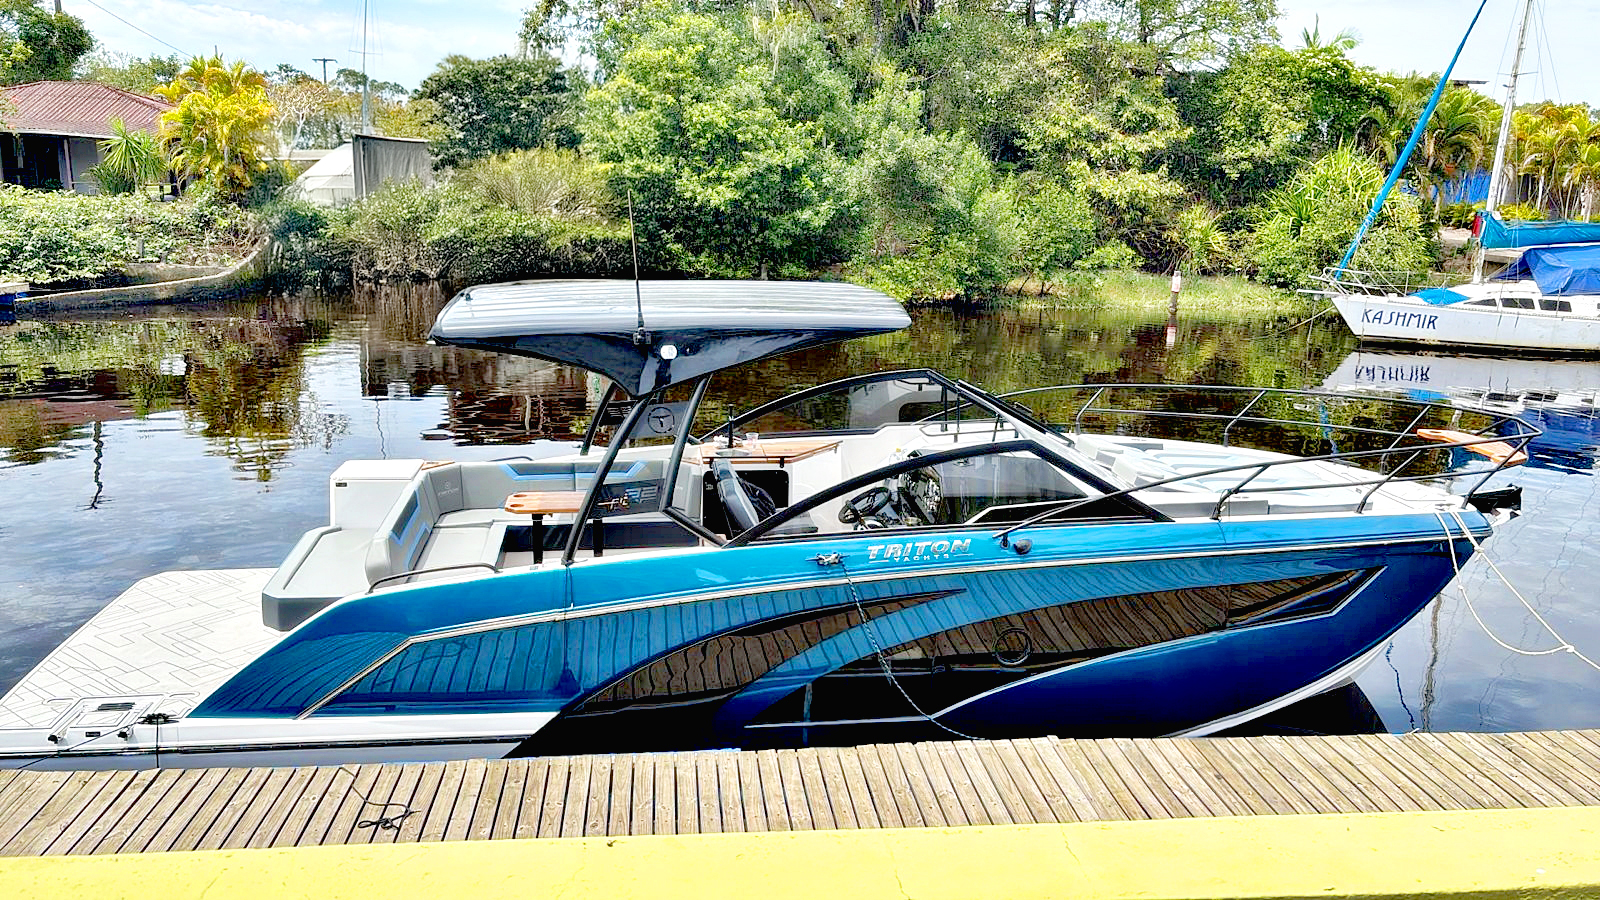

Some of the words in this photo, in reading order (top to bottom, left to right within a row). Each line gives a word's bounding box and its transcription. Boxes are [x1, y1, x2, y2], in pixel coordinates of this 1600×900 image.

[1361, 309, 1438, 330] KASHMIR
[867, 539, 972, 559] TRITON
[894, 553, 950, 562] YACHTS
